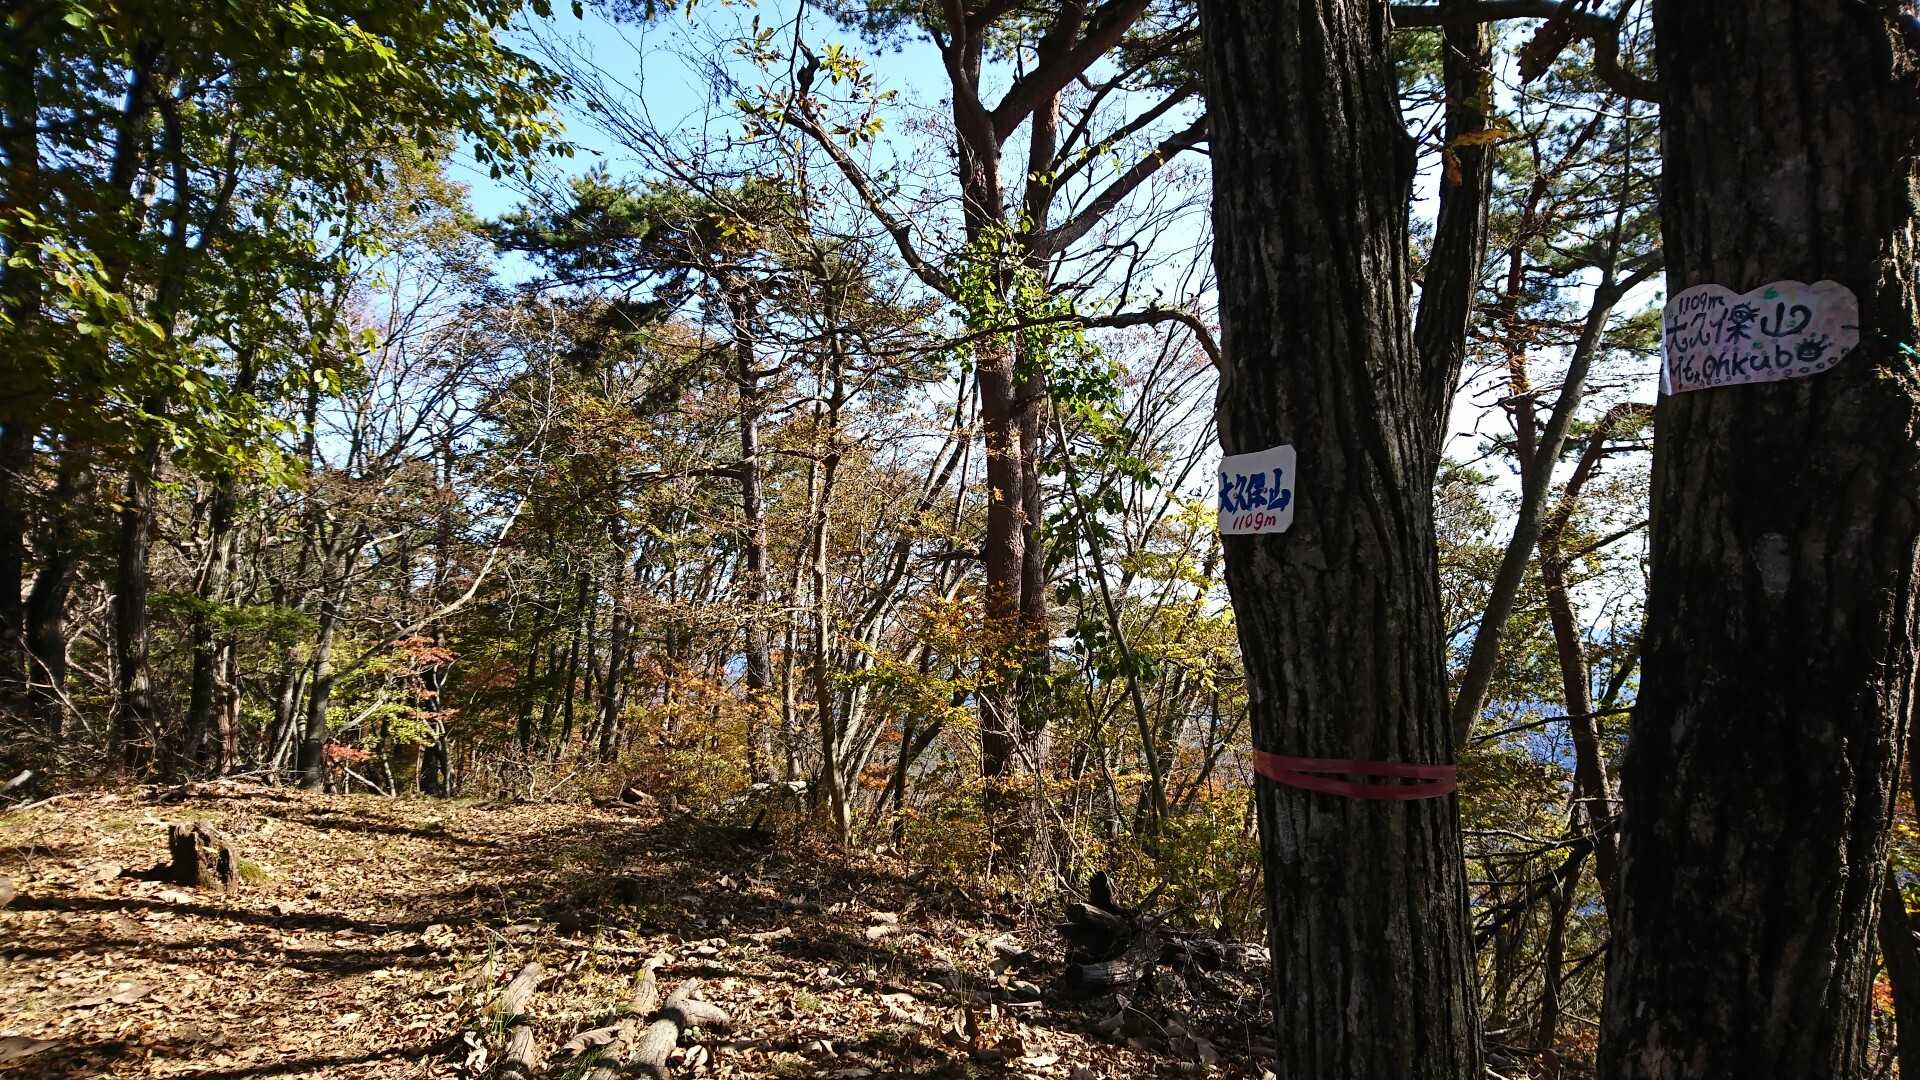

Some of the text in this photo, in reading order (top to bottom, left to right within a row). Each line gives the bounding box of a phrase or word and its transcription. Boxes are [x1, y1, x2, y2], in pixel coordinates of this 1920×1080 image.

[1219, 467, 1292, 515] 大久保山
[1232, 511, 1277, 531] 1109m
